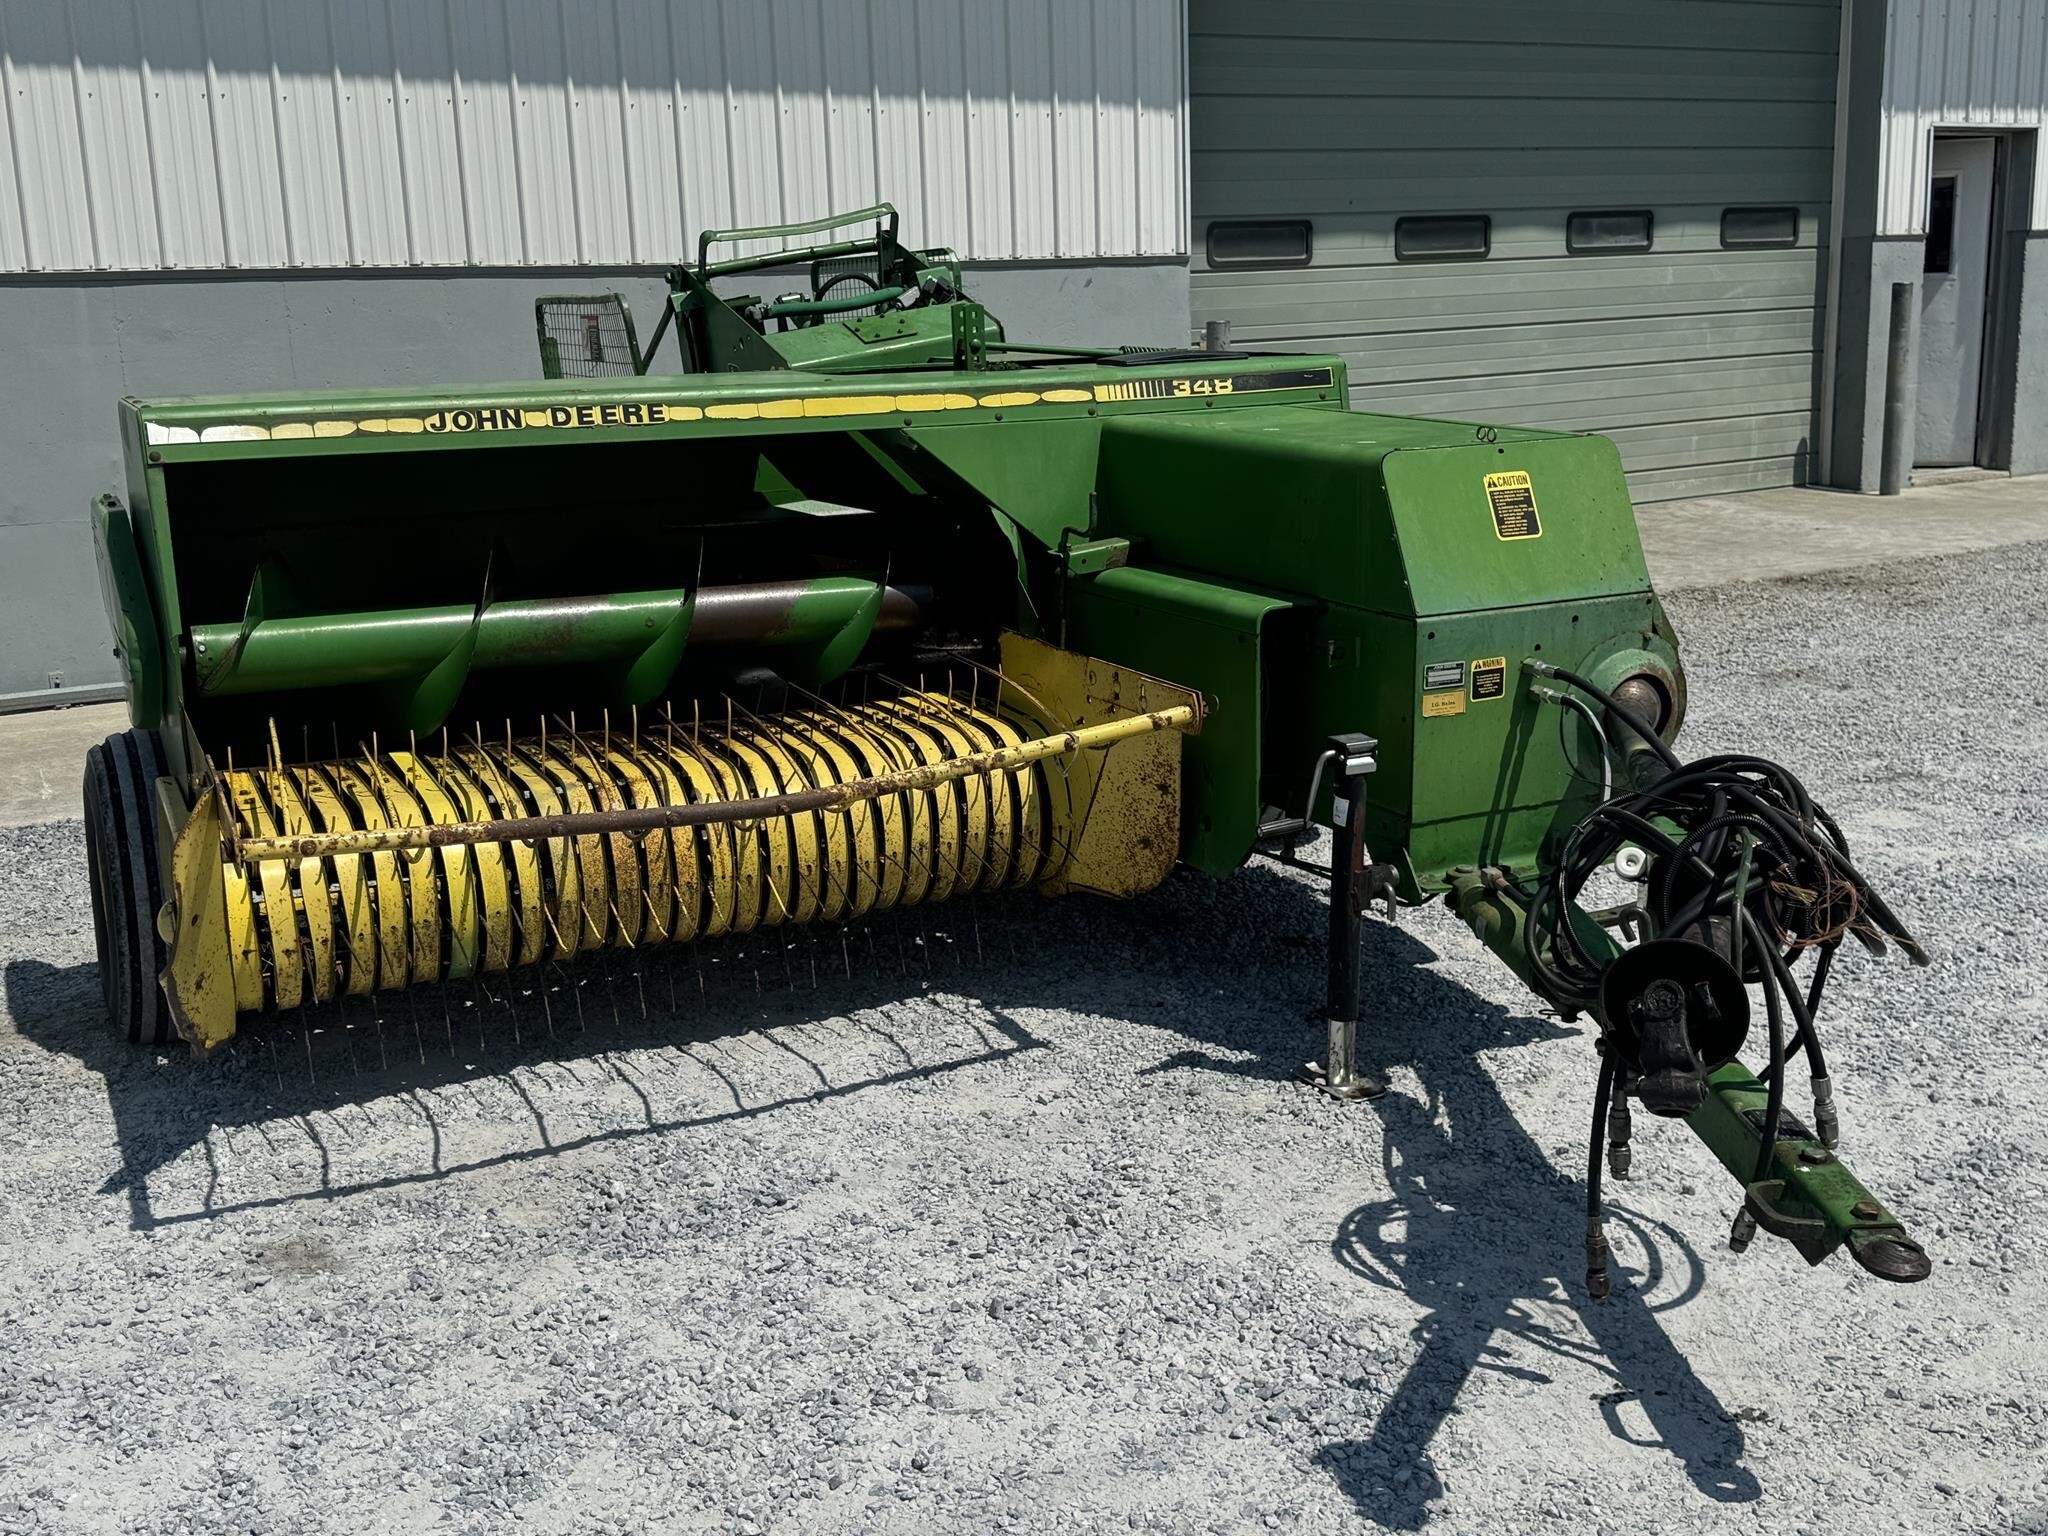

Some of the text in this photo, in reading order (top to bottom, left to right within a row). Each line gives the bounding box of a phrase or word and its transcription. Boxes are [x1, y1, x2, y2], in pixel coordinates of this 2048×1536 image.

[1172, 377, 1233, 397] 348
[429, 403, 666, 432] JOHN DEERE
[1496, 474, 1529, 488] CAUTION
[1482, 658, 1503, 668] WARNING
